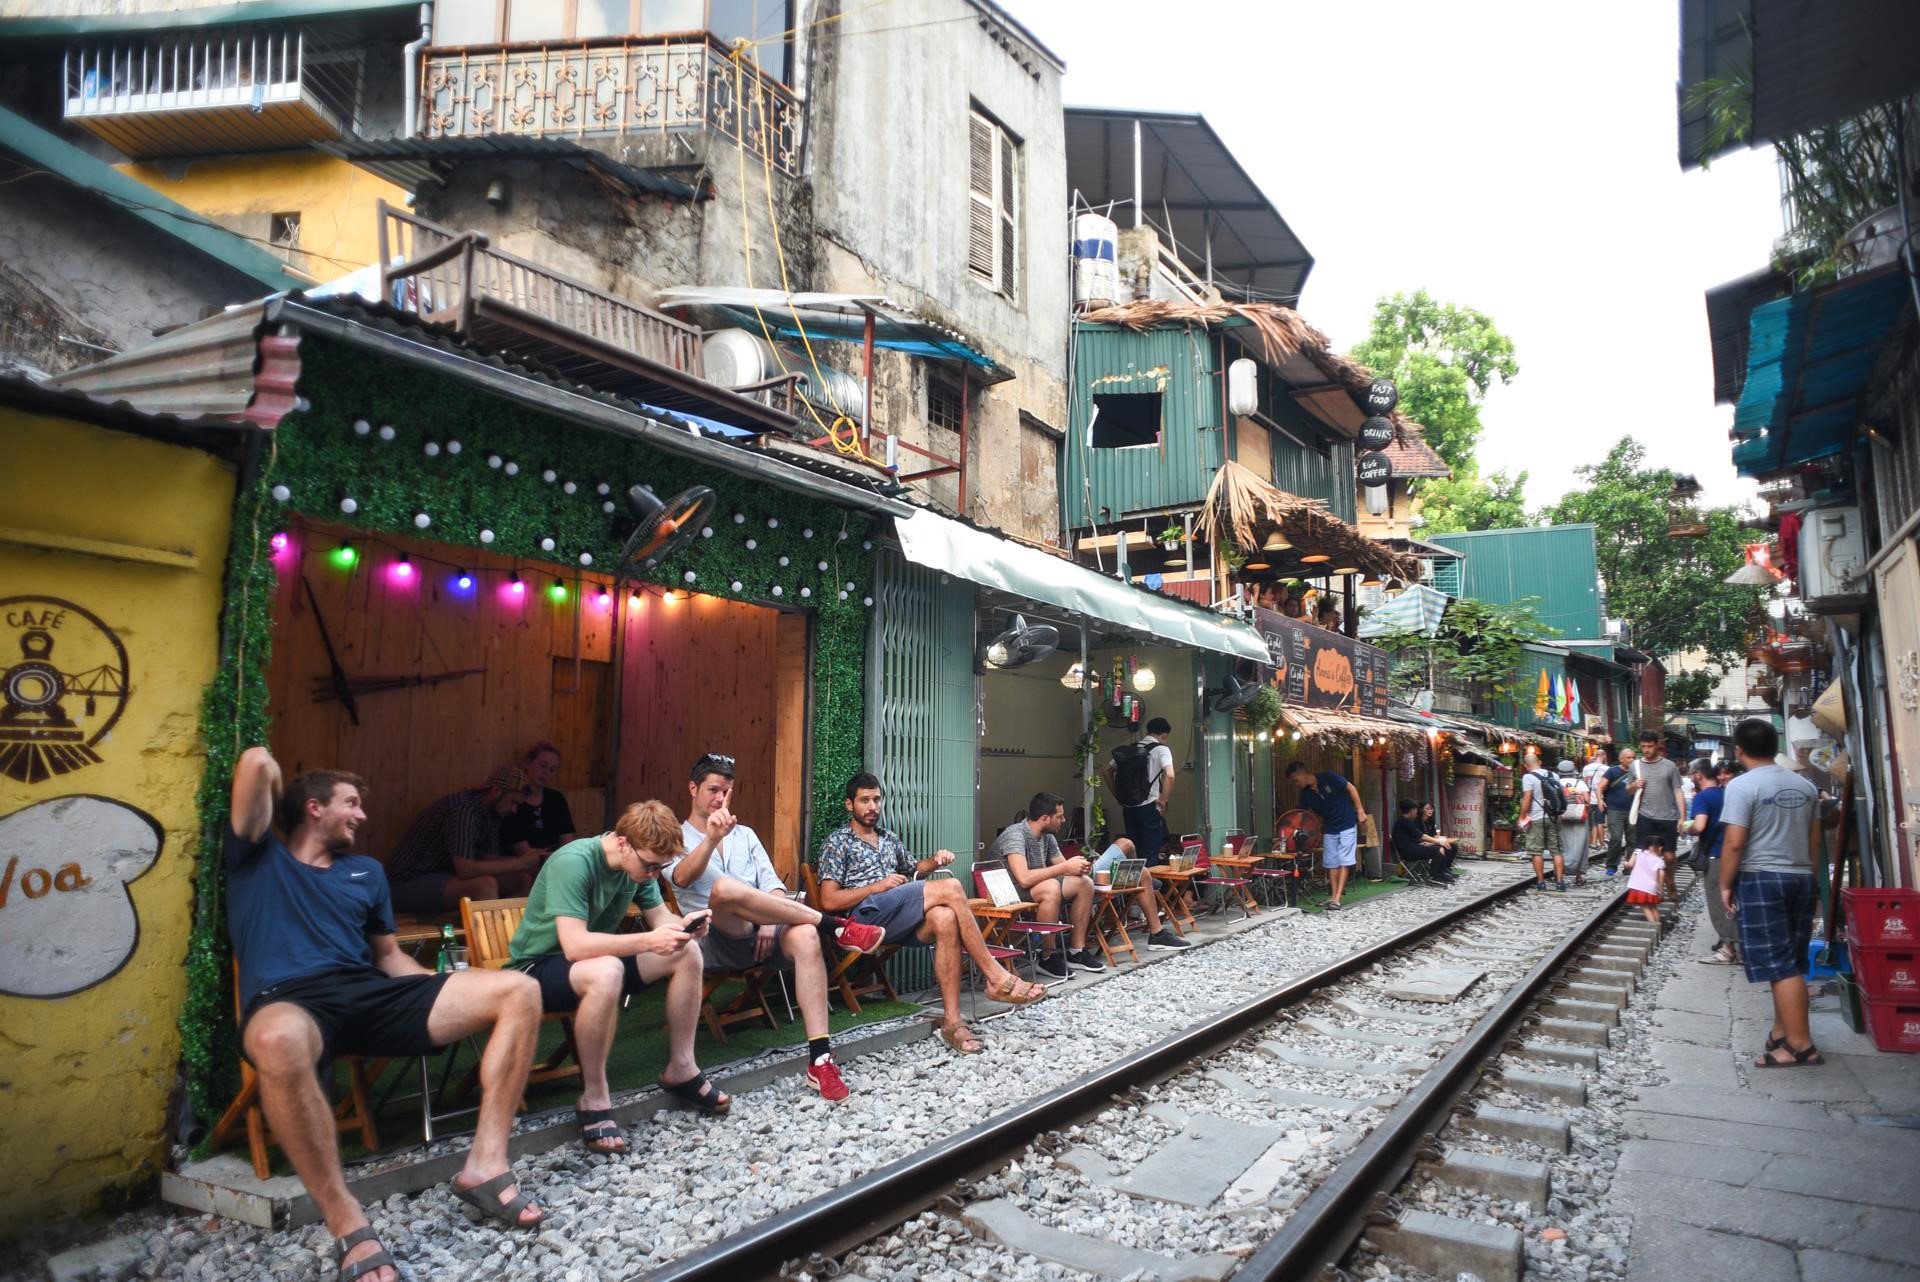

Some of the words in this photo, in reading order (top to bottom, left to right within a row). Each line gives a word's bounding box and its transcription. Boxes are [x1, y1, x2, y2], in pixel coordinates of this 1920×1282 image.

[1371, 384, 1393, 394] FAST
[1368, 394, 1390, 404] FOOD
[1363, 428, 1392, 440] DRINKS
[1362, 460, 1377, 469] EGG
[1360, 468, 1387, 479] COFFEE
[6, 609, 67, 629] CAFÉ
